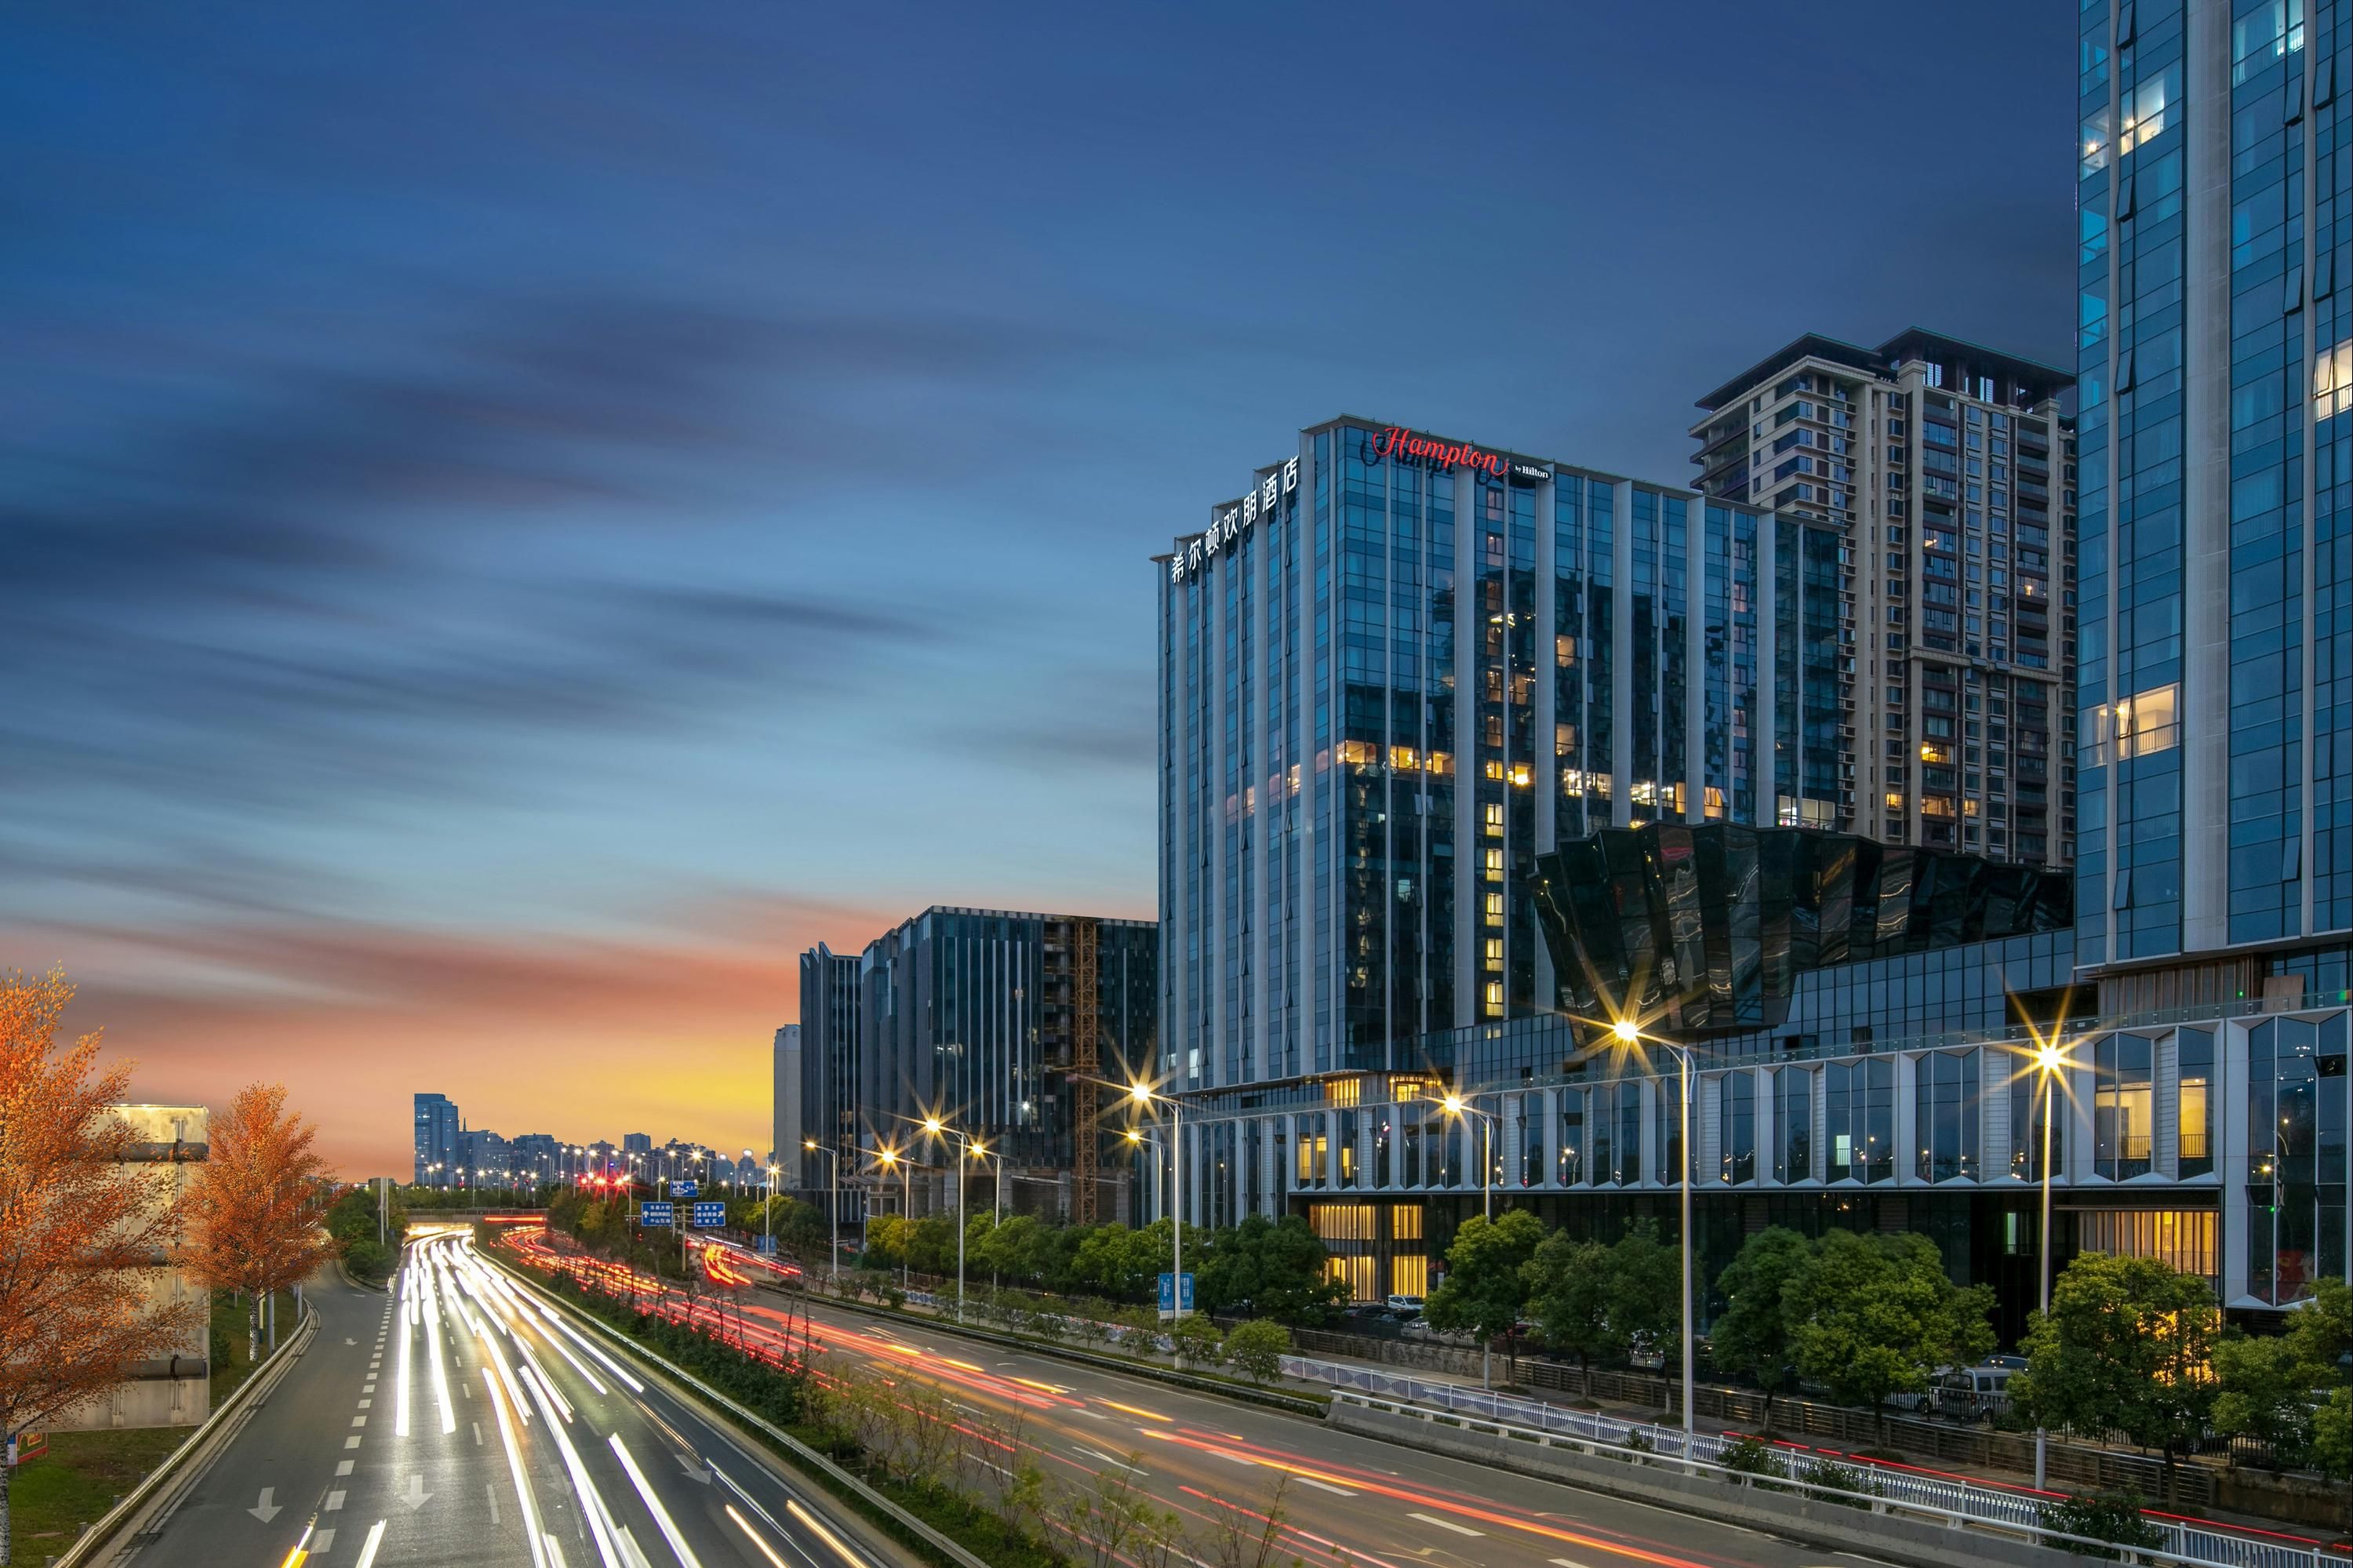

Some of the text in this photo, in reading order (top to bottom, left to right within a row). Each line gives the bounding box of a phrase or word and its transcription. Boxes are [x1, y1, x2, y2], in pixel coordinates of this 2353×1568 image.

[1373, 427, 1508, 476] Hampton
[1522, 465, 1549, 478] Hilton
[1172, 455, 1299, 583] 希尔顿欢朋酒店
